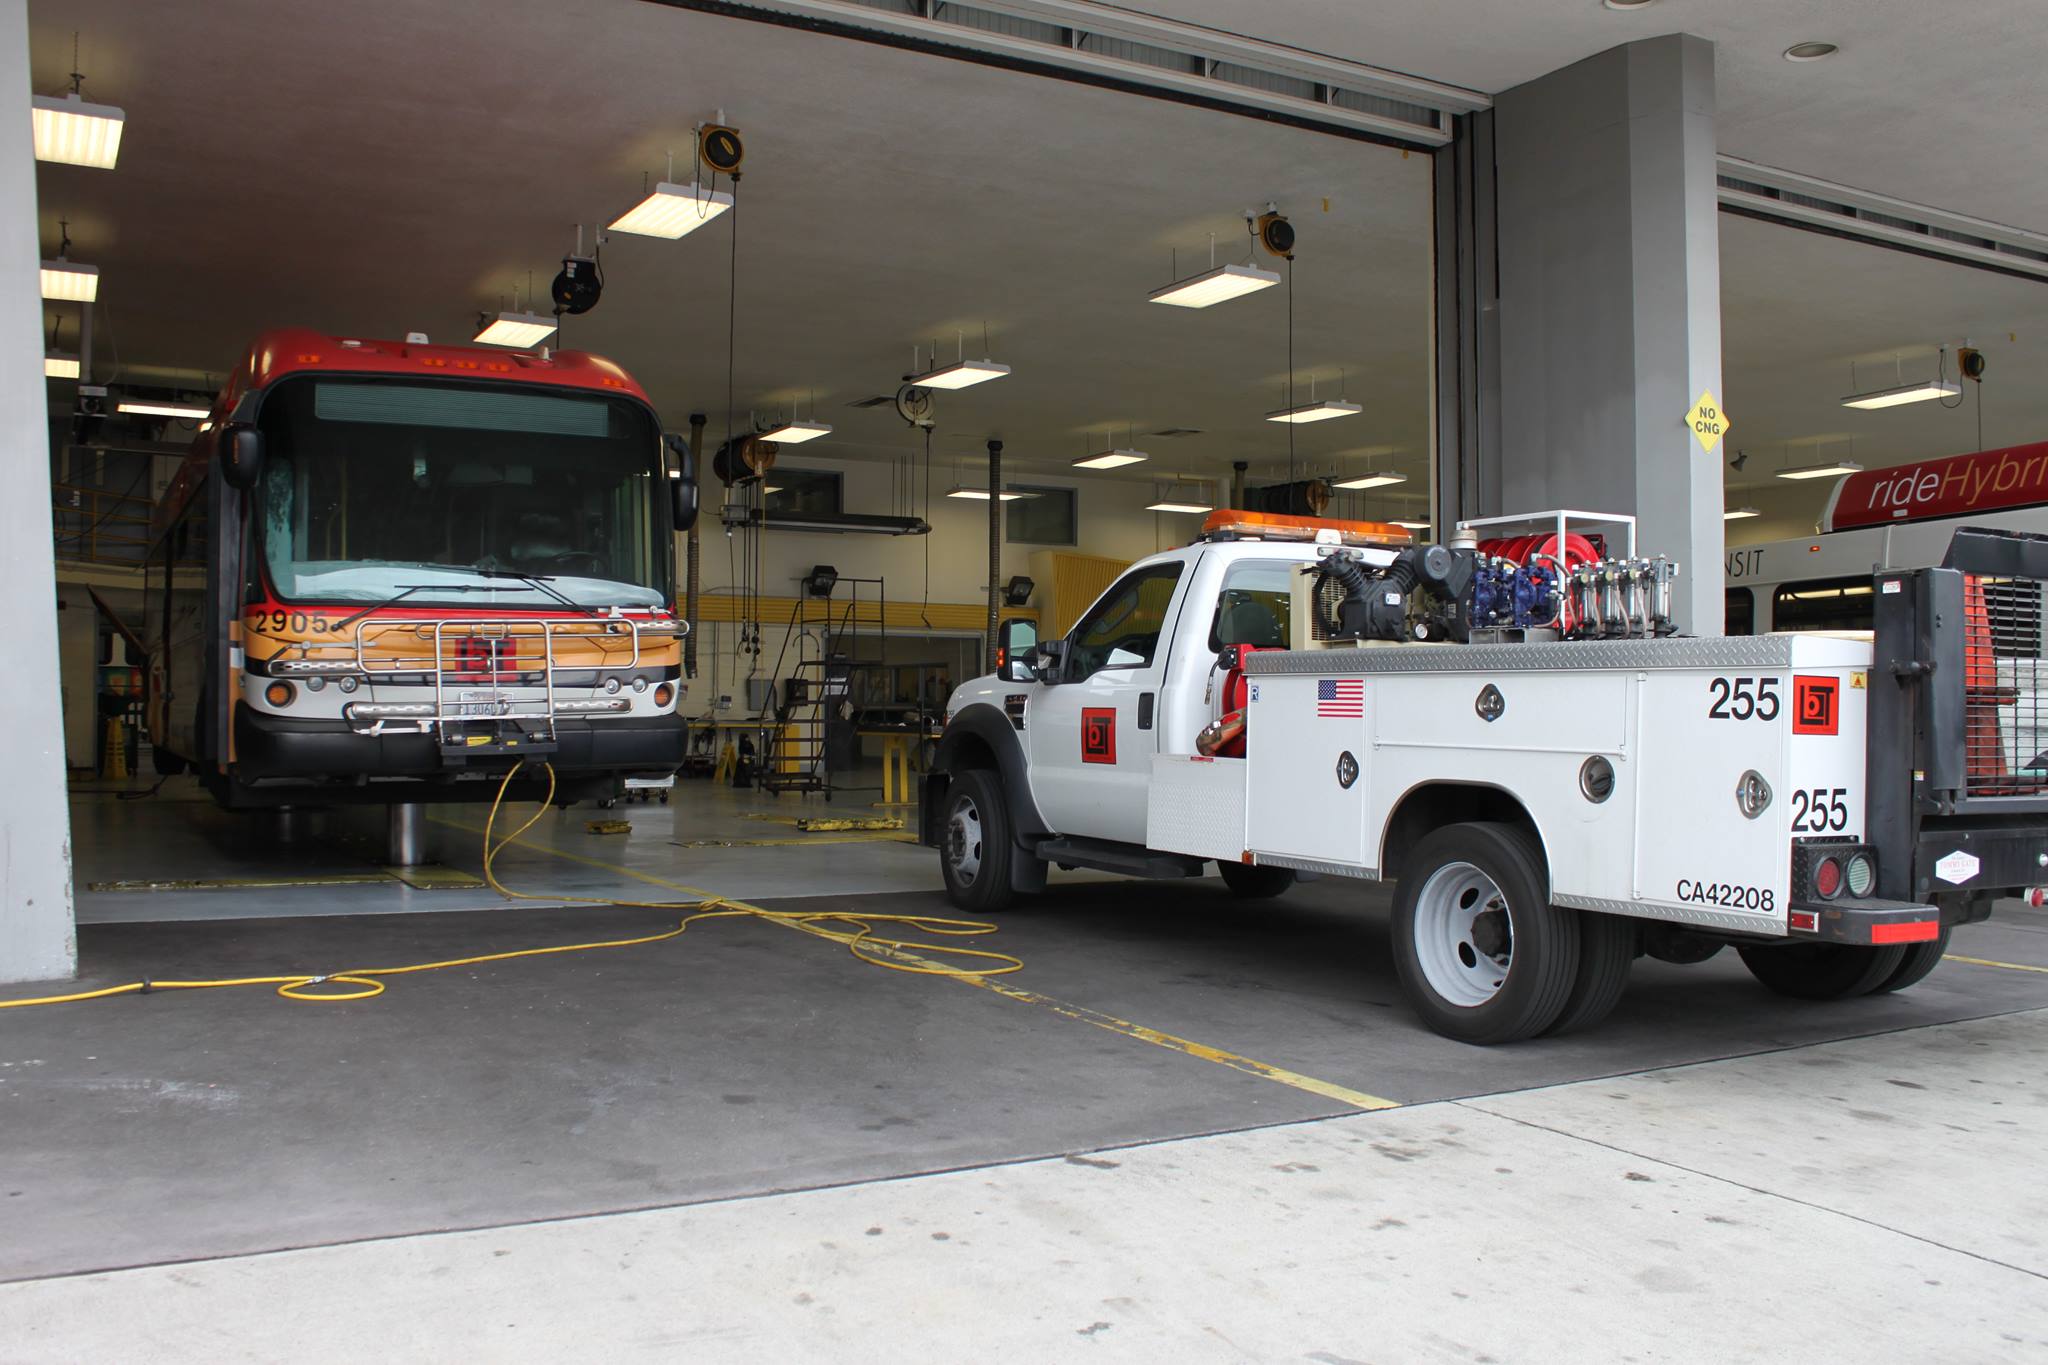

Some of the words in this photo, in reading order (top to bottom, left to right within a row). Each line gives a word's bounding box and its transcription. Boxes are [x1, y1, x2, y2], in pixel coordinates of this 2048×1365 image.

[1695, 420, 1721, 435] CNG
[1699, 406, 1716, 420] NO
[255, 609, 328, 634] 2905
[1708, 677, 1780, 721] 255
[1790, 788, 1848, 833] 255
[1676, 879, 1775, 912] CA42208
